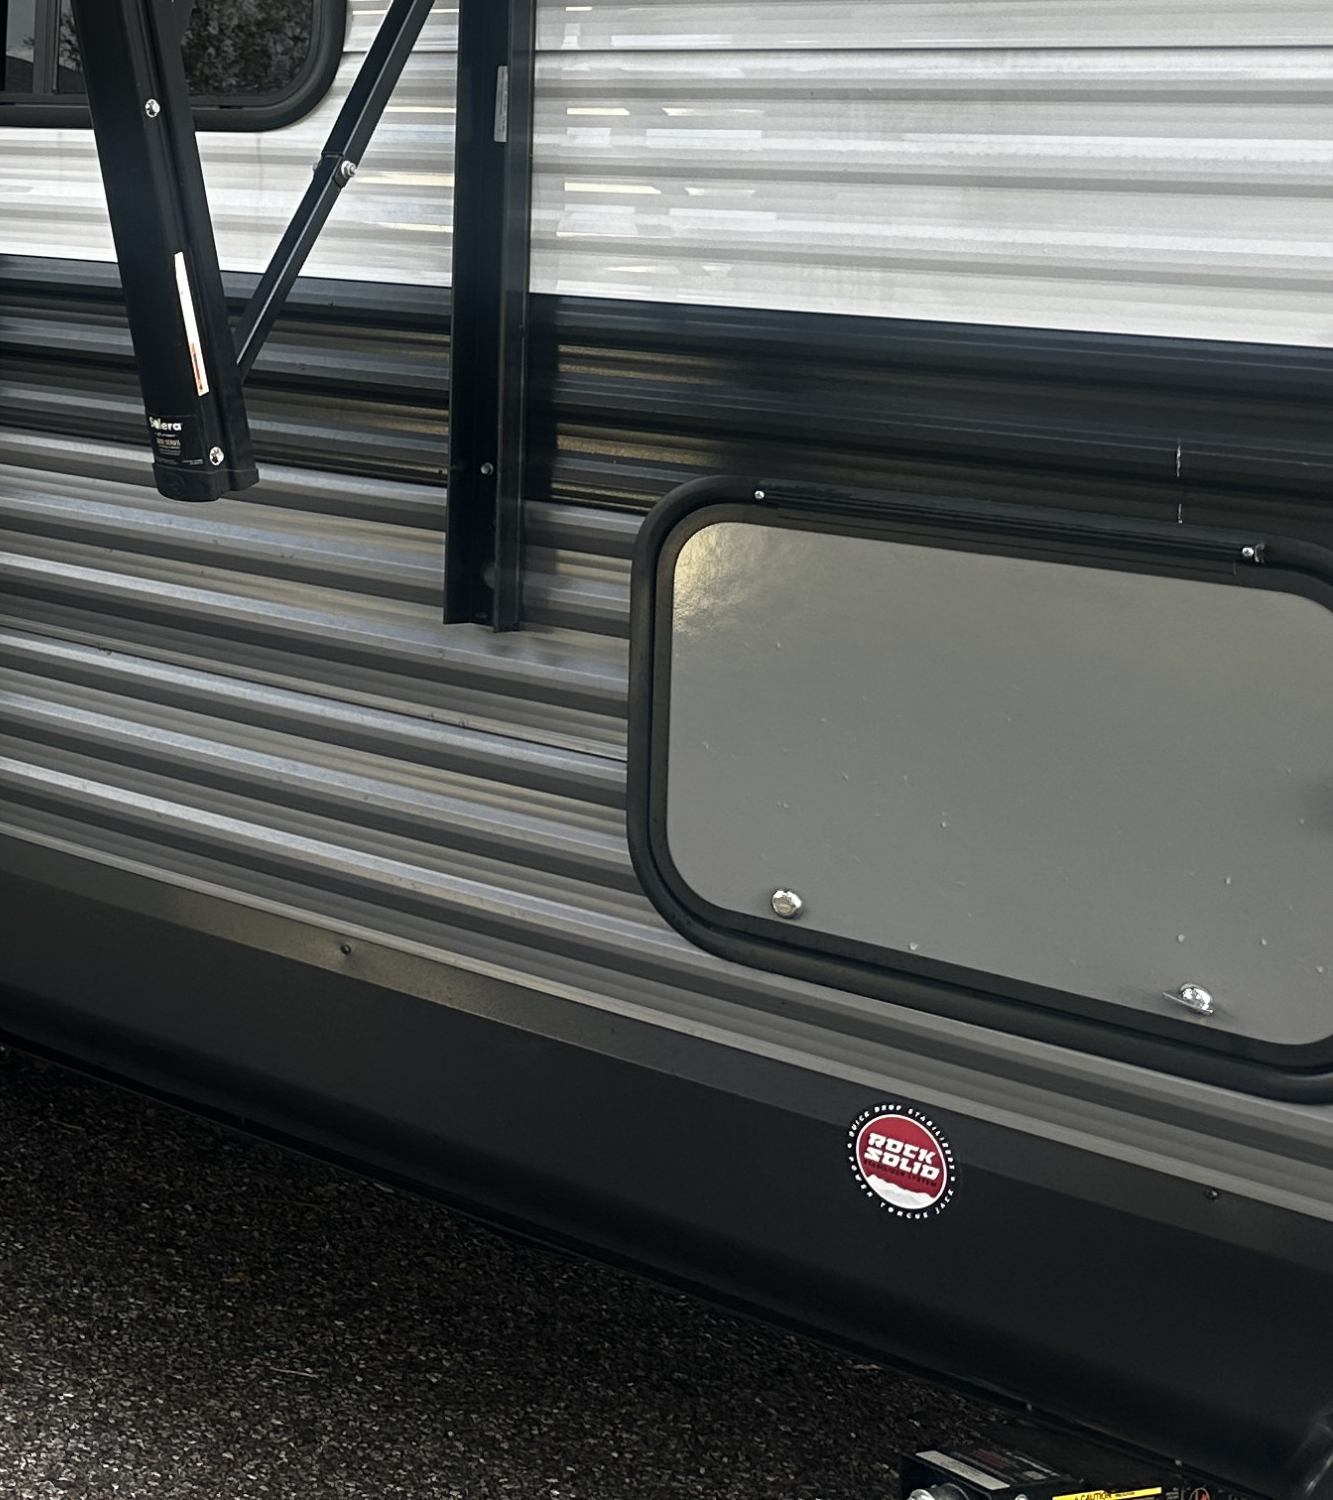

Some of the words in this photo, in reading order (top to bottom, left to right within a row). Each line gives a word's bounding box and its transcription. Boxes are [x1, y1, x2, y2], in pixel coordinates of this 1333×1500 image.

[874, 1104, 902, 1113] DROP
[867, 1132, 936, 1164] ROCK
[864, 1146, 940, 1180] SOLID
[935, 1189, 954, 1215] JACK
